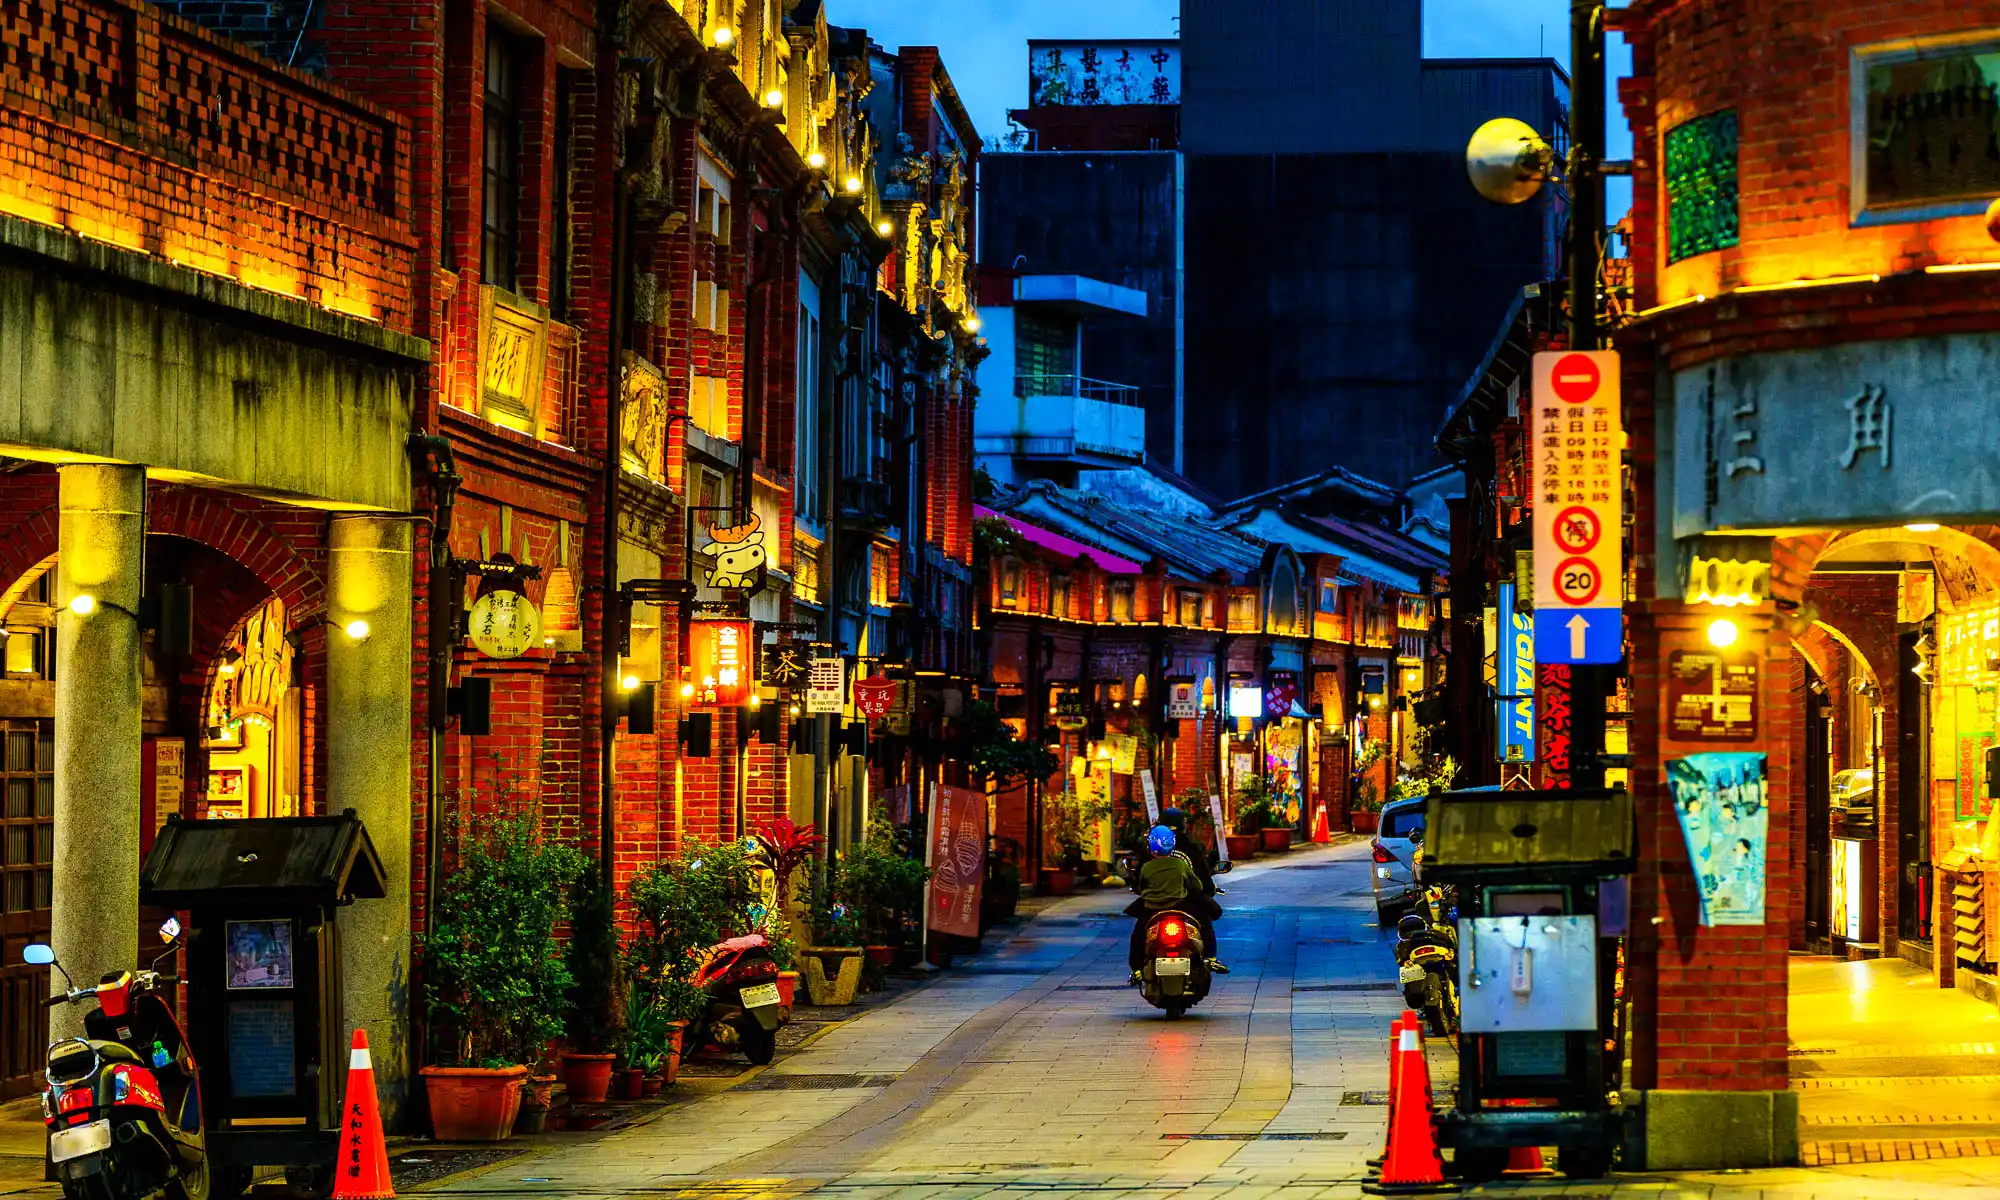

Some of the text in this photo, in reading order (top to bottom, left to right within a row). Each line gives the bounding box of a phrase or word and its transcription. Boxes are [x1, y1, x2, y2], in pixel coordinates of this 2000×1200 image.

[1542, 407, 1561, 504] 禁止進入及停車
[1564, 572, 1591, 589] 20
[483, 612, 495, 635] 文石
[773, 649, 806, 684] 茶
[858, 688, 890, 701] 童玩
[1514, 632, 1534, 741] GIANT
